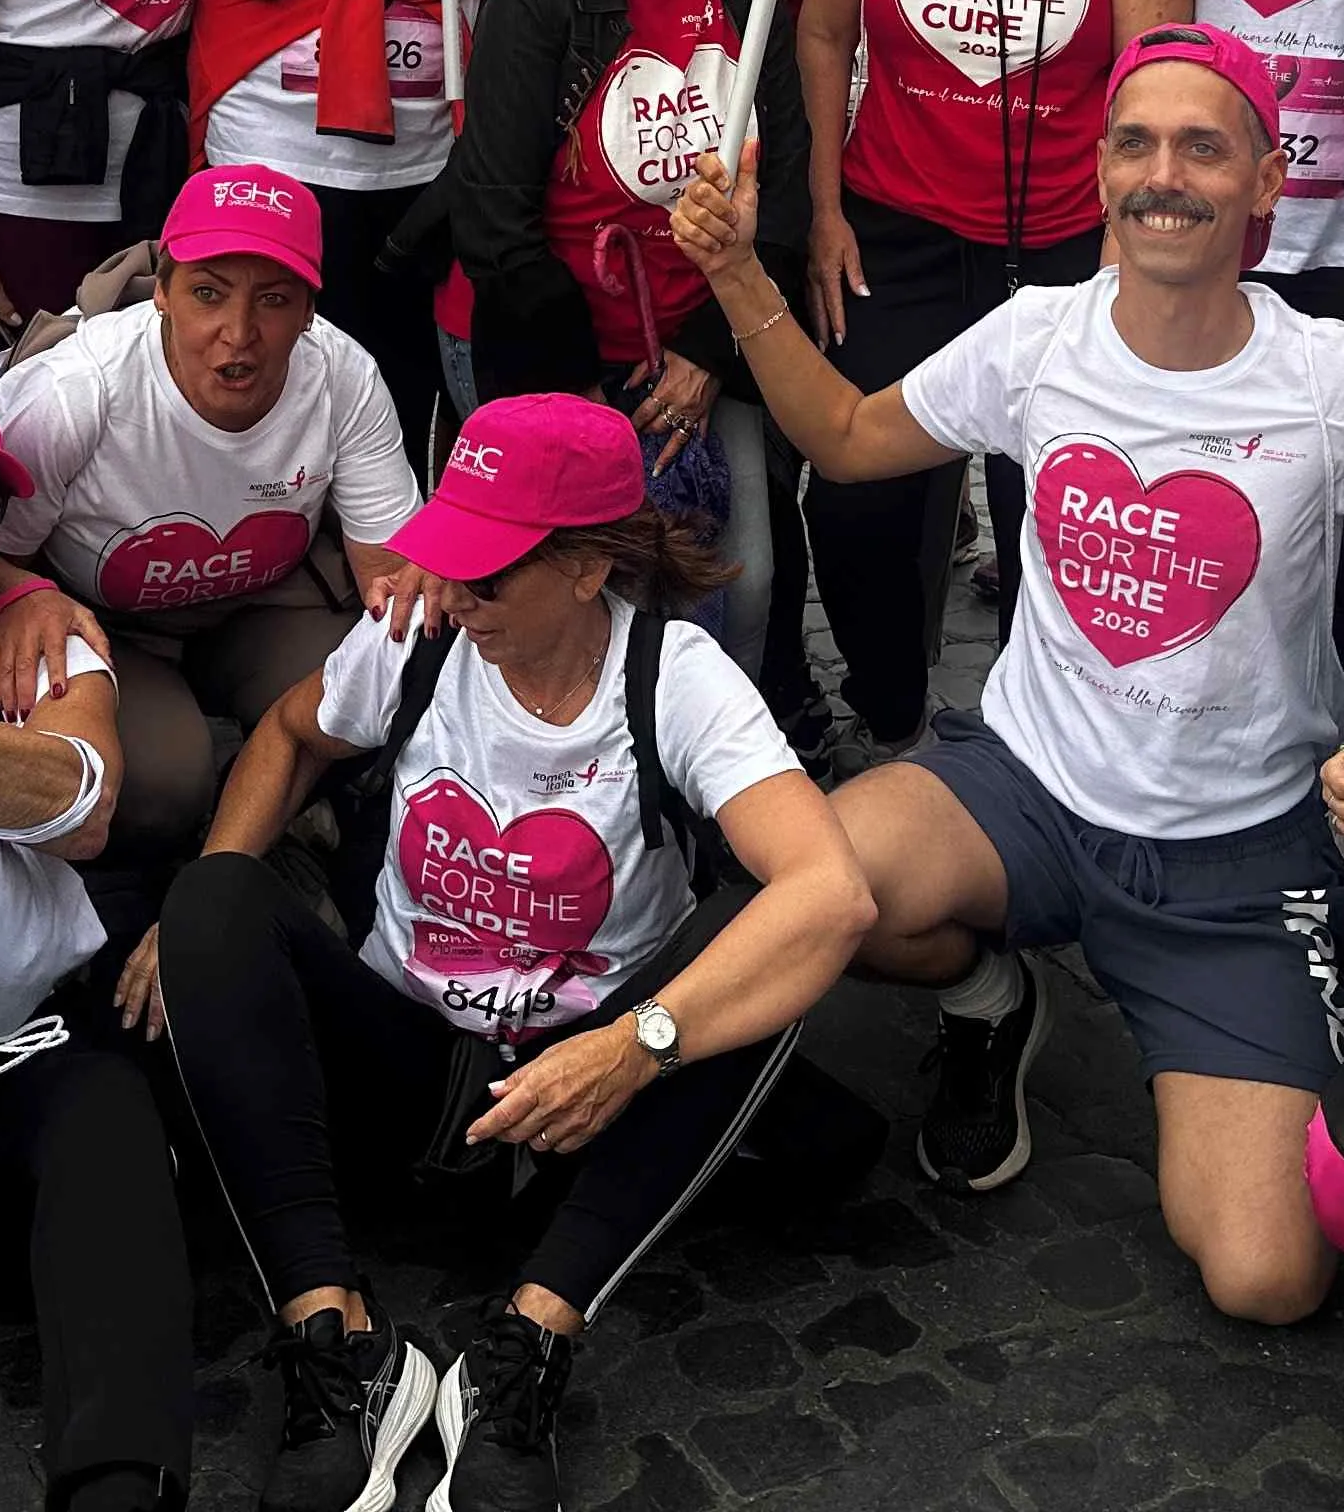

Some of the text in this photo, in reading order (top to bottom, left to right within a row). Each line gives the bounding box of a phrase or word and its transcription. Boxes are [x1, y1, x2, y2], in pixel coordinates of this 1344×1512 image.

[921, 3, 1024, 41] CURE
[632, 85, 709, 124] RACE
[985, 90, 1004, 108] dell
[637, 113, 727, 155] FOR TH
[229, 181, 293, 212] GHC
[1060, 485, 1180, 544] RACE
[143, 549, 255, 585] RACE
[1059, 525, 1224, 591] FOR THE
[136, 560, 290, 606] FOR THE
[1058, 557, 1167, 615] CURE
[1090, 607, 1150, 639] 2026
[425, 822, 533, 884] RACE
[419, 858, 582, 923] FOR THE
